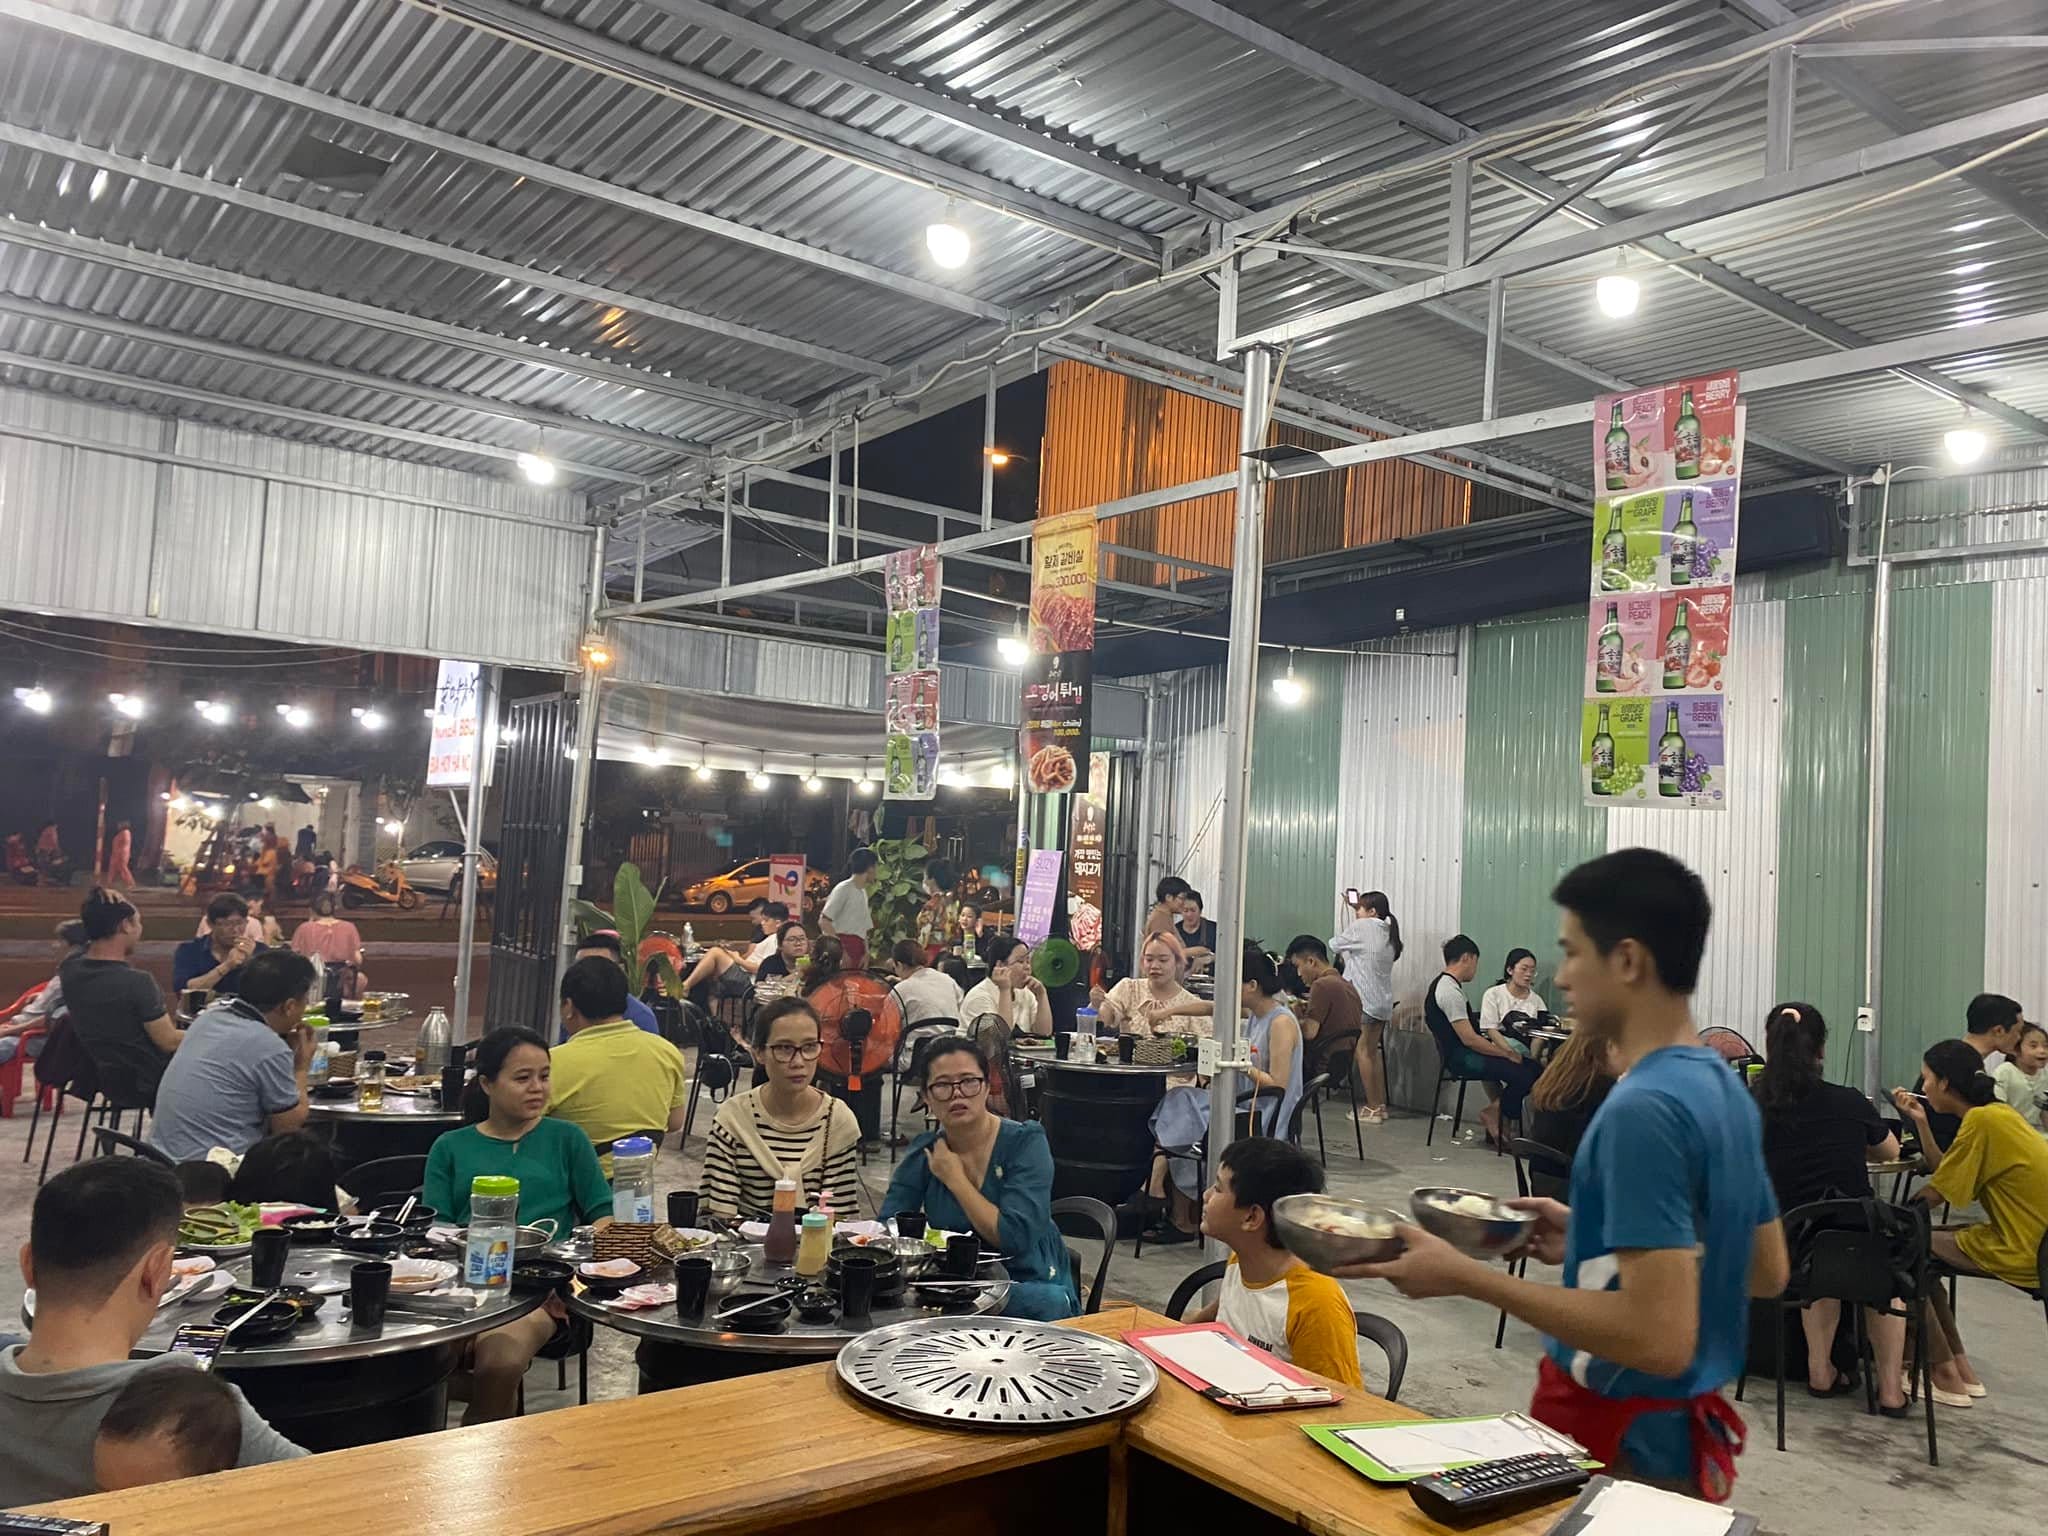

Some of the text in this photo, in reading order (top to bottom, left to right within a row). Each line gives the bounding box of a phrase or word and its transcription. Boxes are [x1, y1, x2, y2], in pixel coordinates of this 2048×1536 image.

[1633, 506, 1657, 518] GRAPE
[1628, 609, 1652, 620] PEACH
[1620, 712, 1644, 723] GRAPE
[1692, 712, 1718, 723] BERRY
